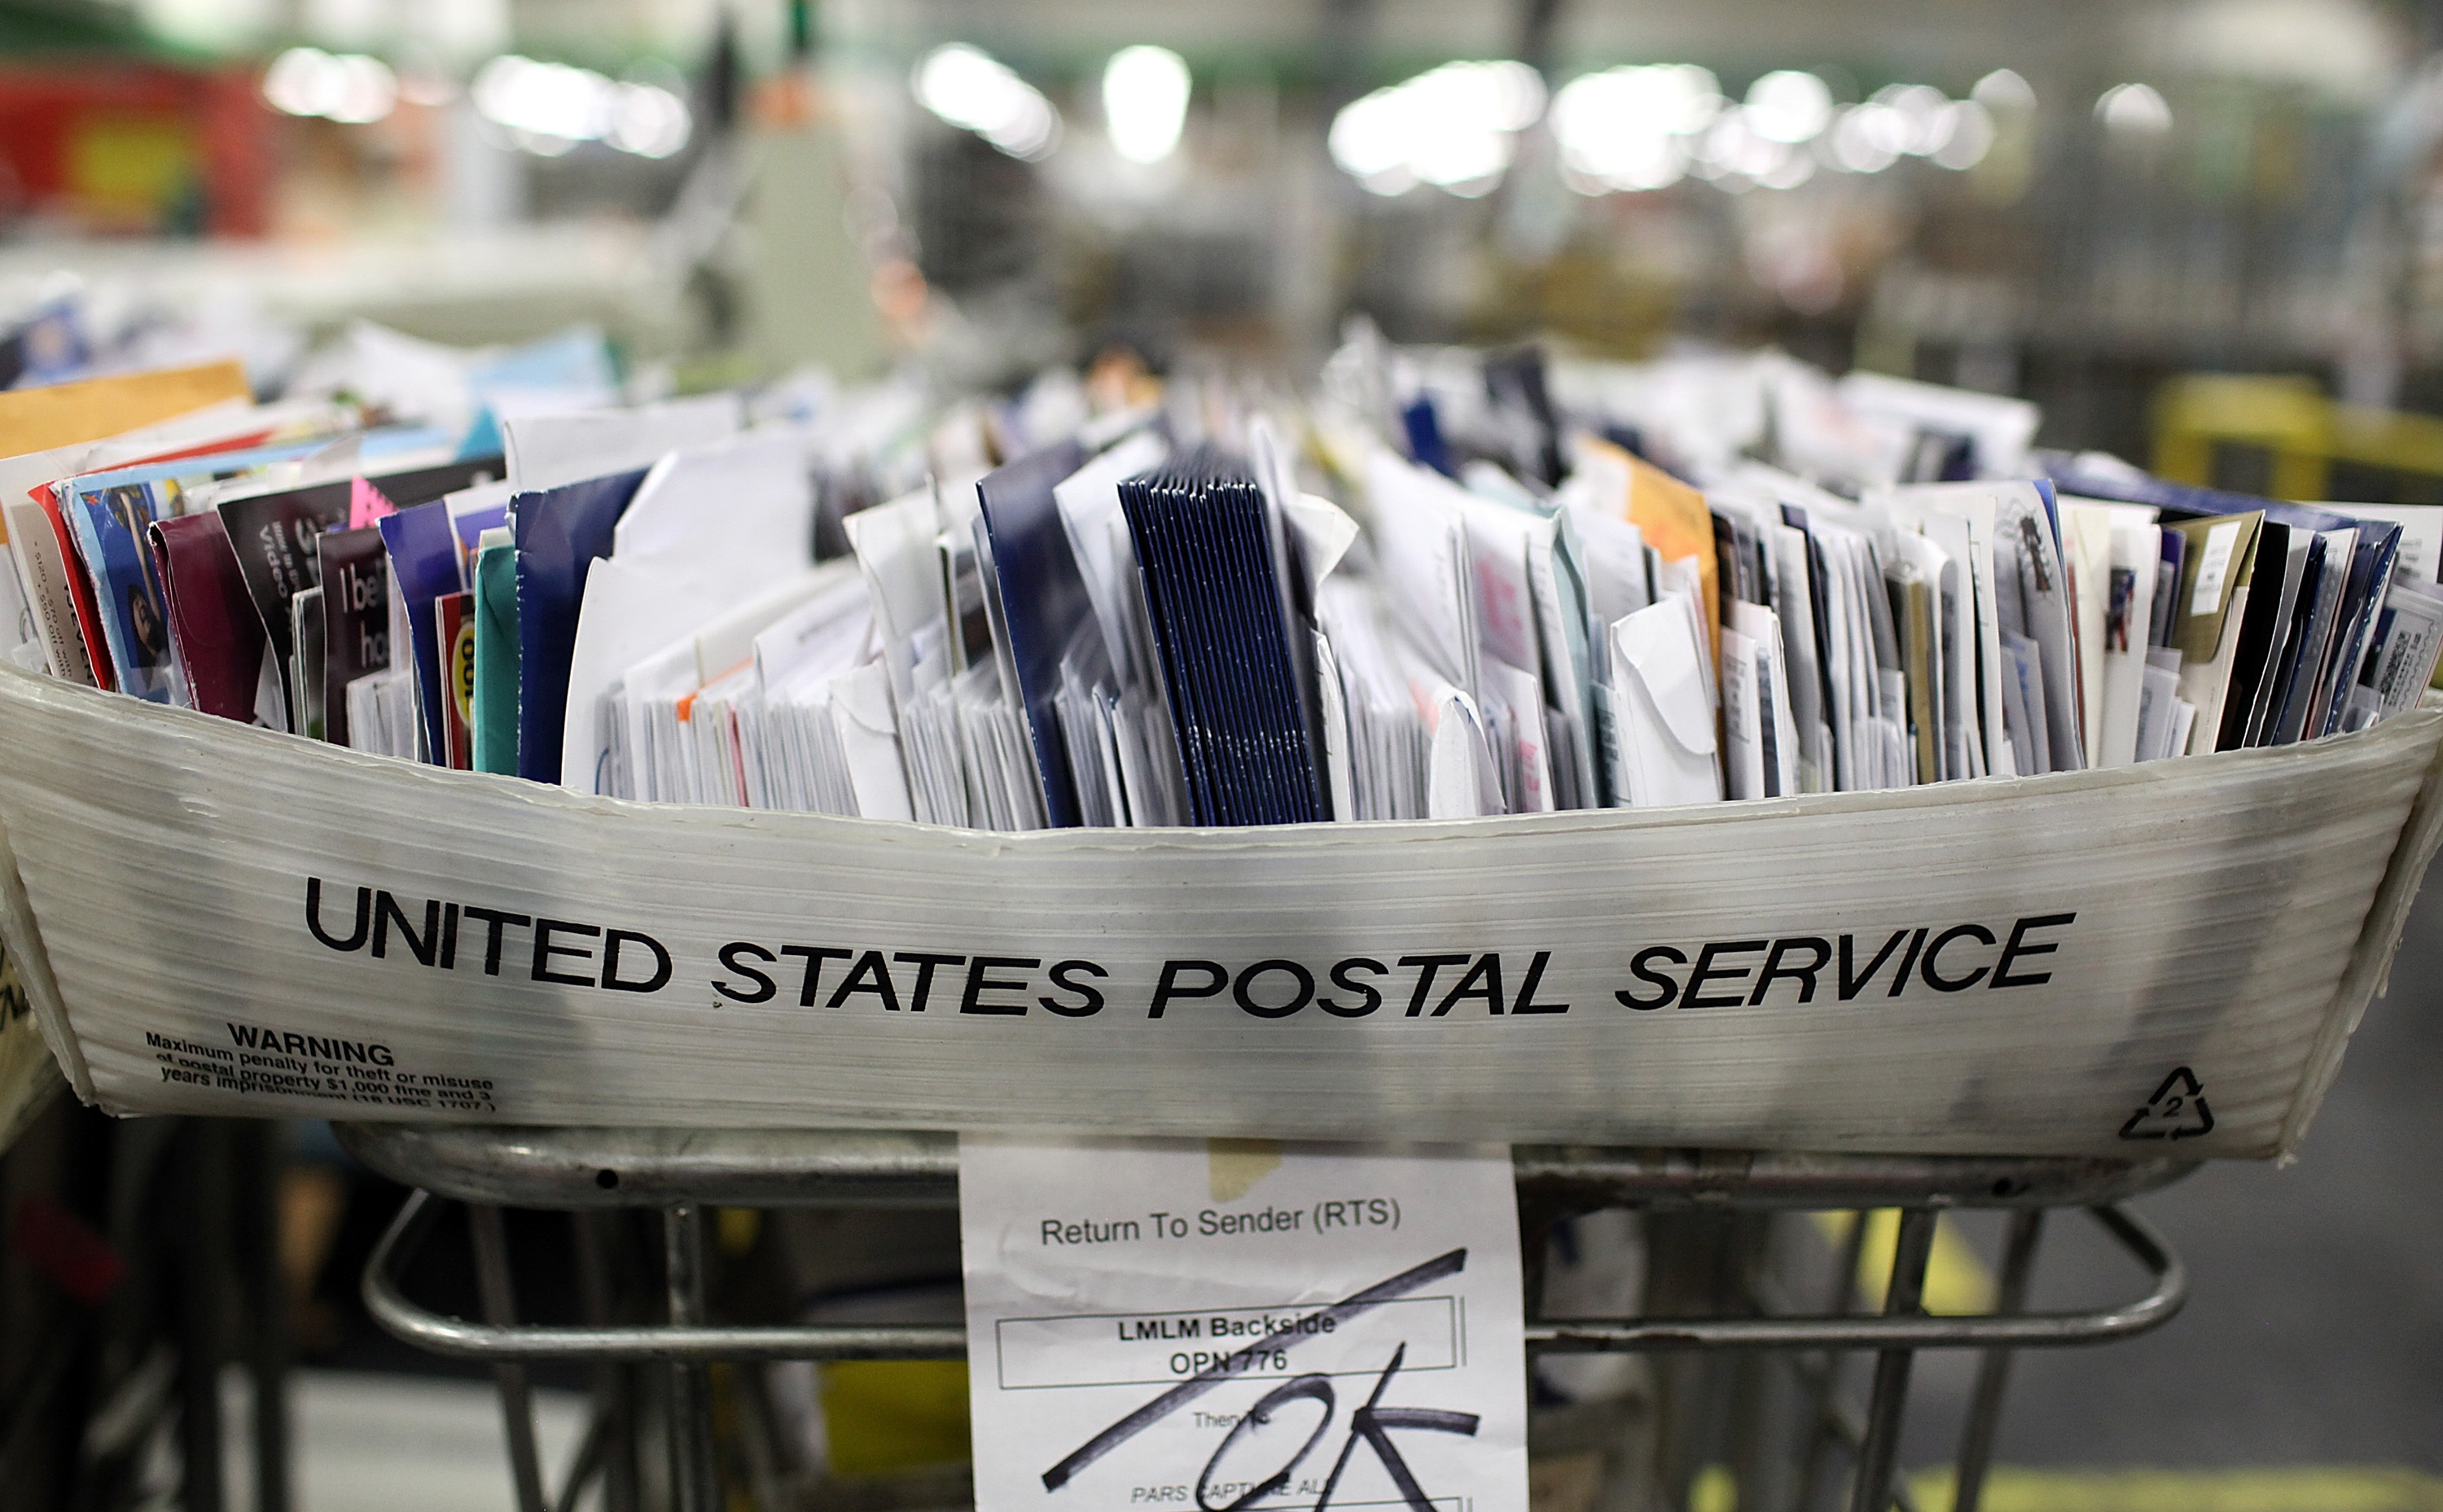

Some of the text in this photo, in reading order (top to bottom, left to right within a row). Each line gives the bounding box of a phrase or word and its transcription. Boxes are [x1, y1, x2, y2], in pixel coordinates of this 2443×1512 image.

[306, 878, 2077, 1019] UNITED STATES POSTAL SERVICE
[227, 1023, 394, 1066] WARNING
[146, 1032, 493, 1089] Maximum penalty for theft or misuse
[161, 1067, 210, 1087] years
[178, 1058, 235, 1076] postal
[240, 1069, 320, 1090] property
[327, 1077, 388, 1093] $1,000
[395, 1085, 431, 1098] fine
[437, 1089, 473, 1100] and
[2163, 1096, 2183, 1118] 2
[1042, 1198, 1401, 1245] Return To Sender (RTS)
[1118, 1313, 1336, 1341] LMLM Backside
[1170, 1349, 1287, 1374] OPN 776
[1193, 1411, 1239, 1428] Then
[1131, 1487, 1188, 1504] PARS
